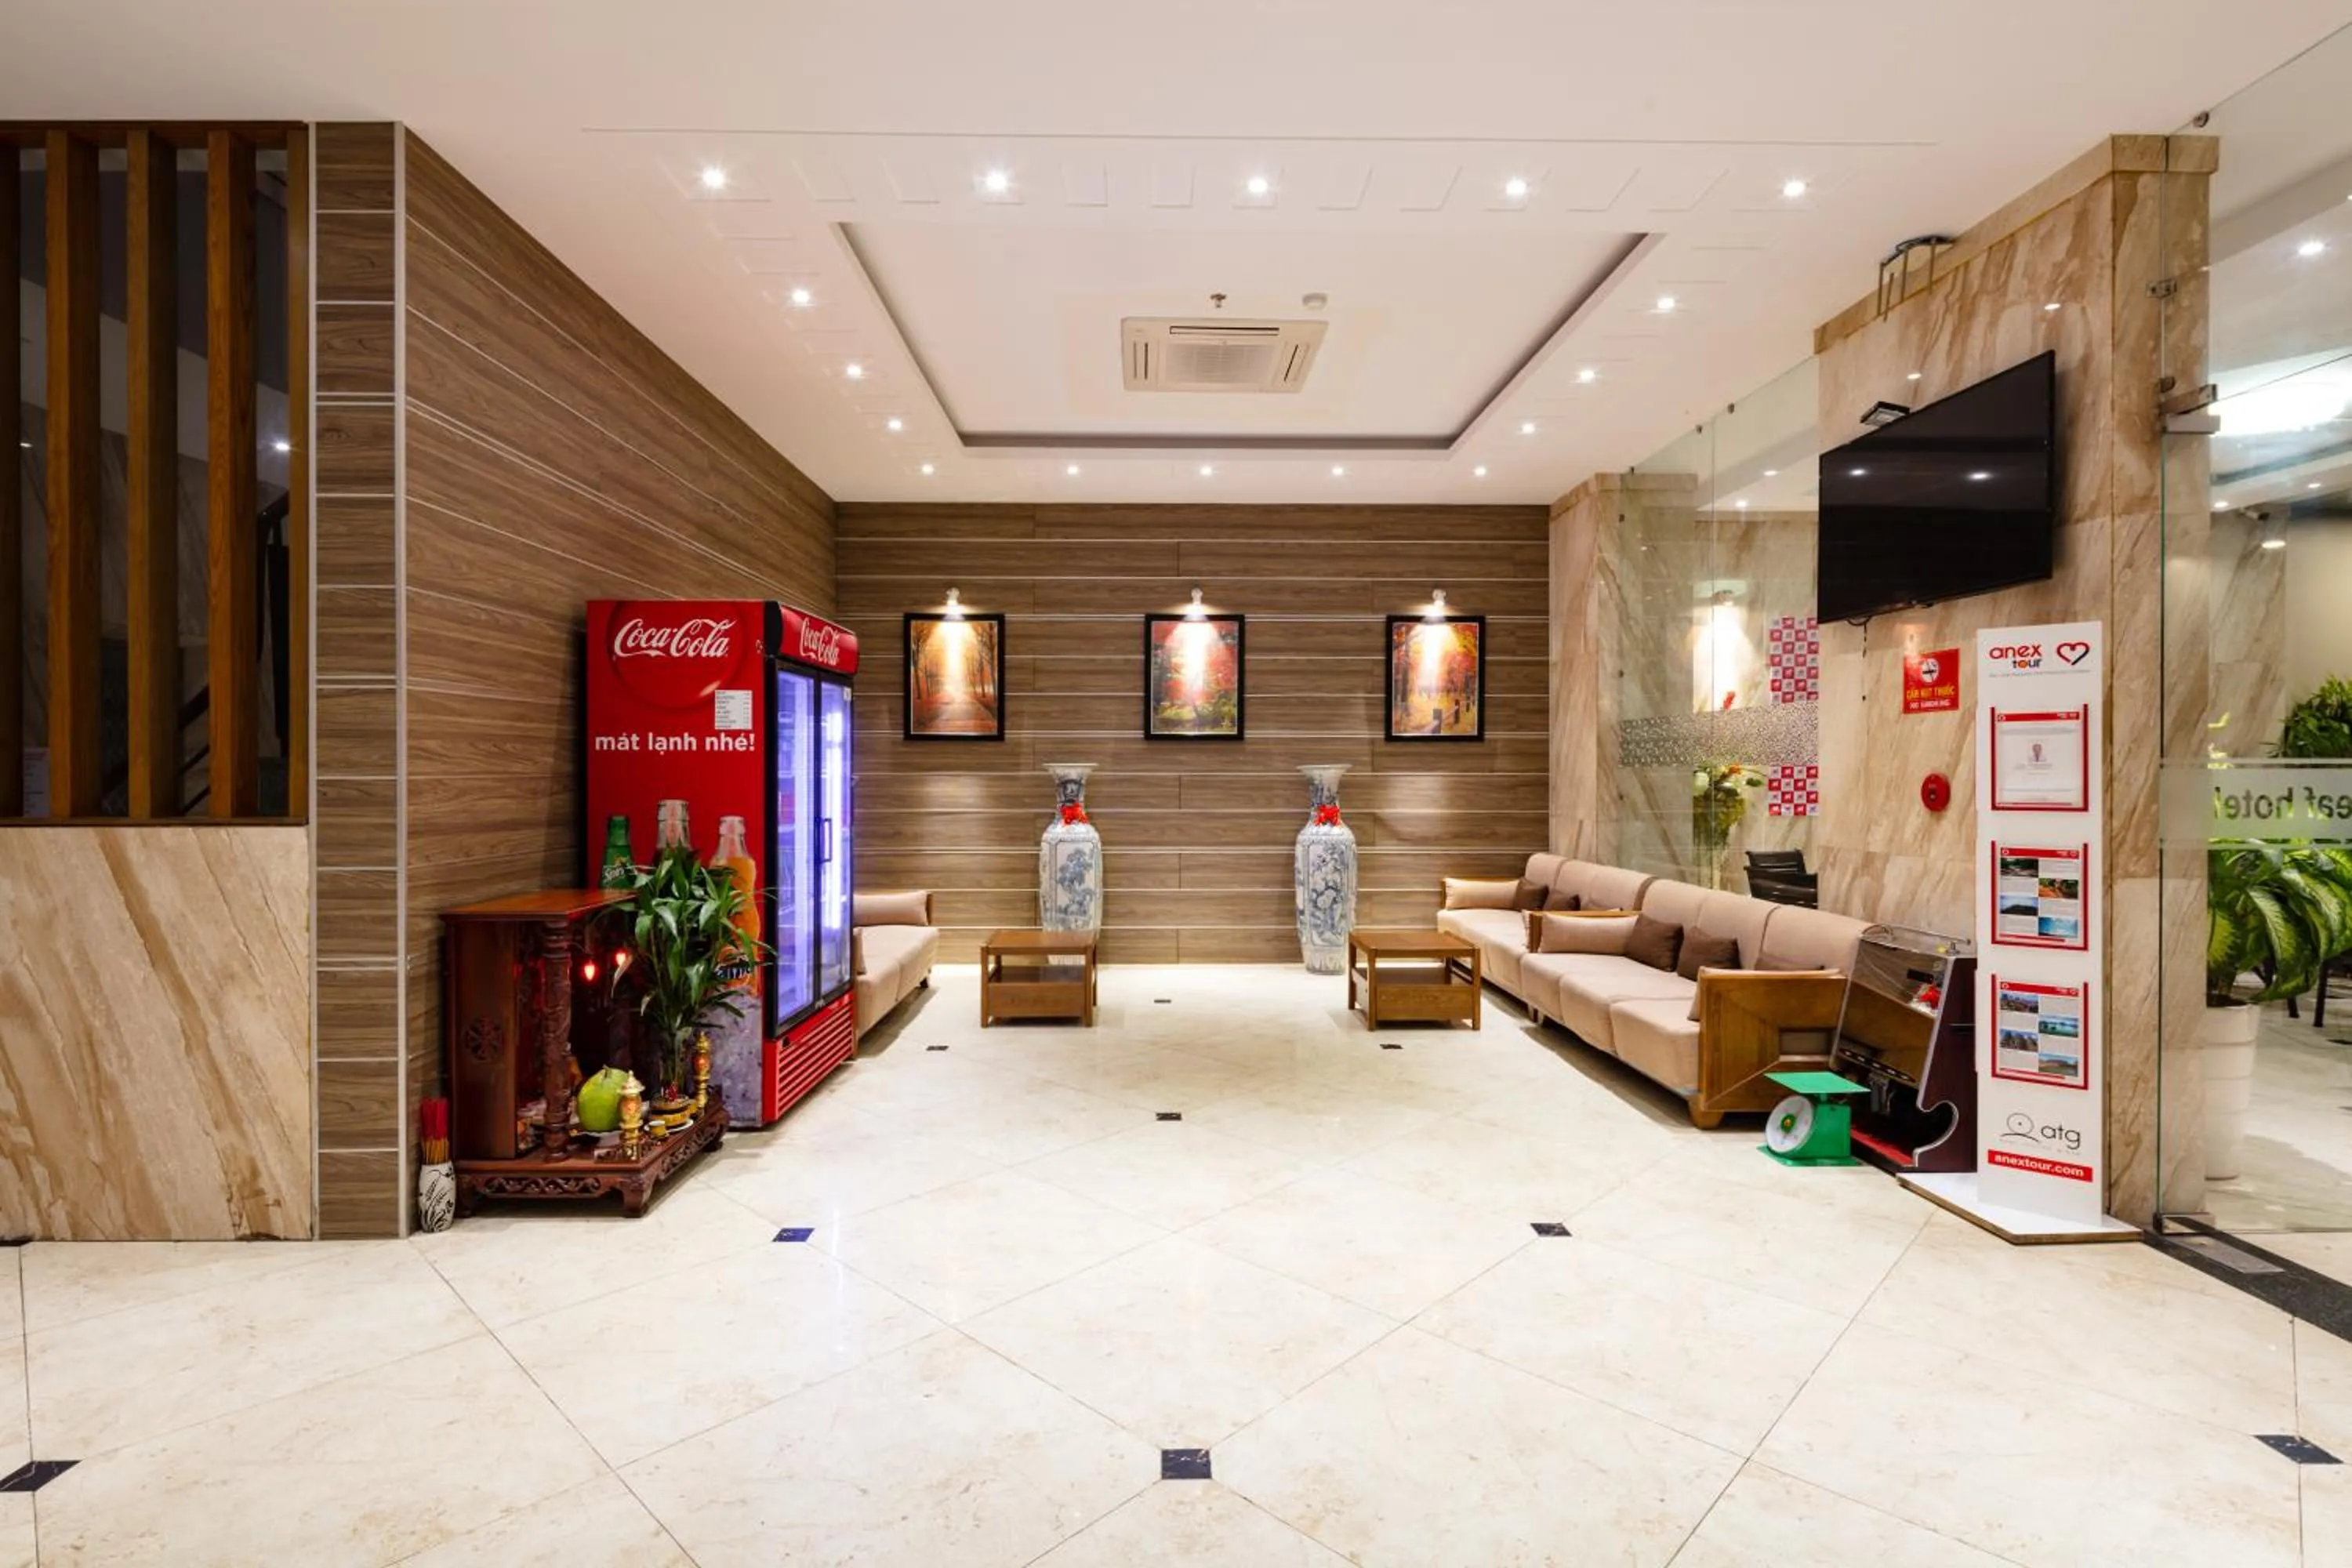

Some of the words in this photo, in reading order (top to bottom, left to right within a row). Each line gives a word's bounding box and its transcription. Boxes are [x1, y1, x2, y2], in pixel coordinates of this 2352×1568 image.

[613, 619, 737, 658] Coca-Cola
[800, 617, 840, 666] Coca-Cola
[1989, 644, 2042, 659] anex
[2012, 659, 2042, 669] tour
[595, 732, 640, 751] mát
[648, 731, 697, 756] lạnh
[705, 731, 755, 751] nhé!
[2041, 1123, 2081, 1150] atg
[1994, 1154, 2085, 1177] anextour.com
